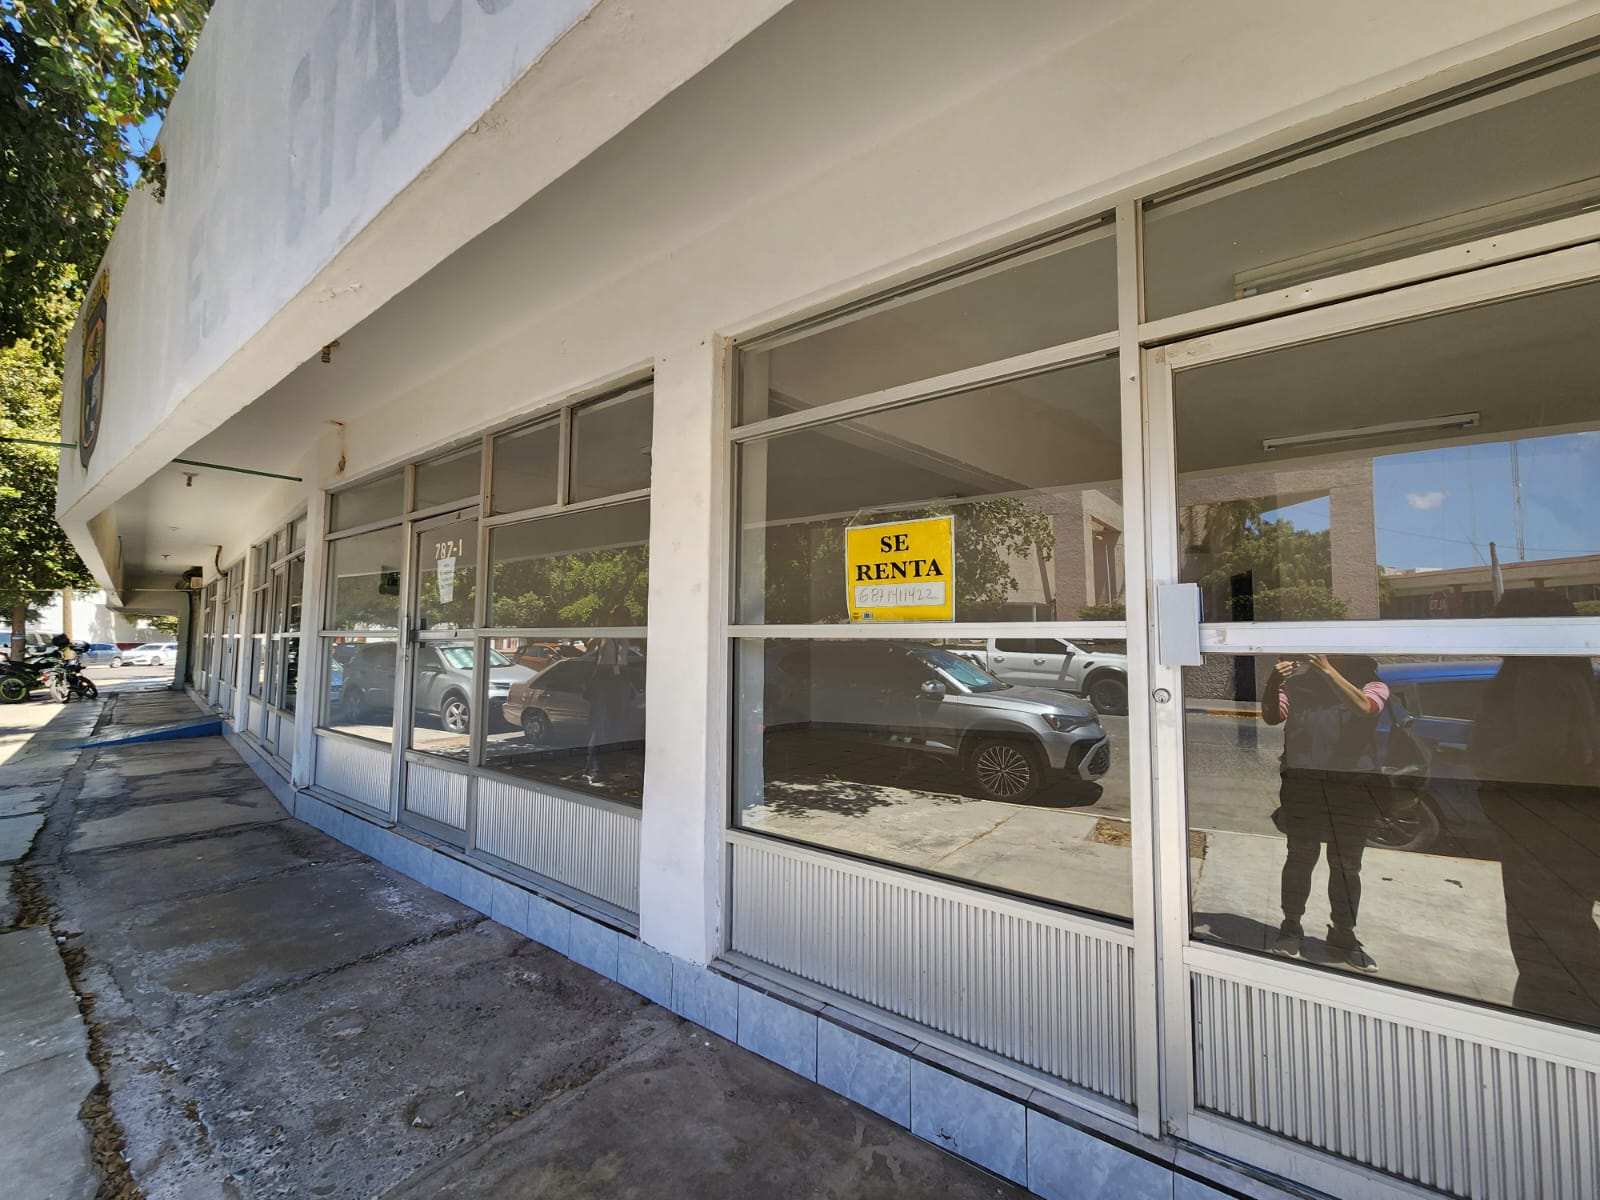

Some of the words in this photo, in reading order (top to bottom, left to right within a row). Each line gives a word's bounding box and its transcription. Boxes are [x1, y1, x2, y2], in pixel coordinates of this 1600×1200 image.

[435, 539, 462, 560] 787-1
[880, 534, 909, 553] SE
[856, 558, 944, 581] RENTA
